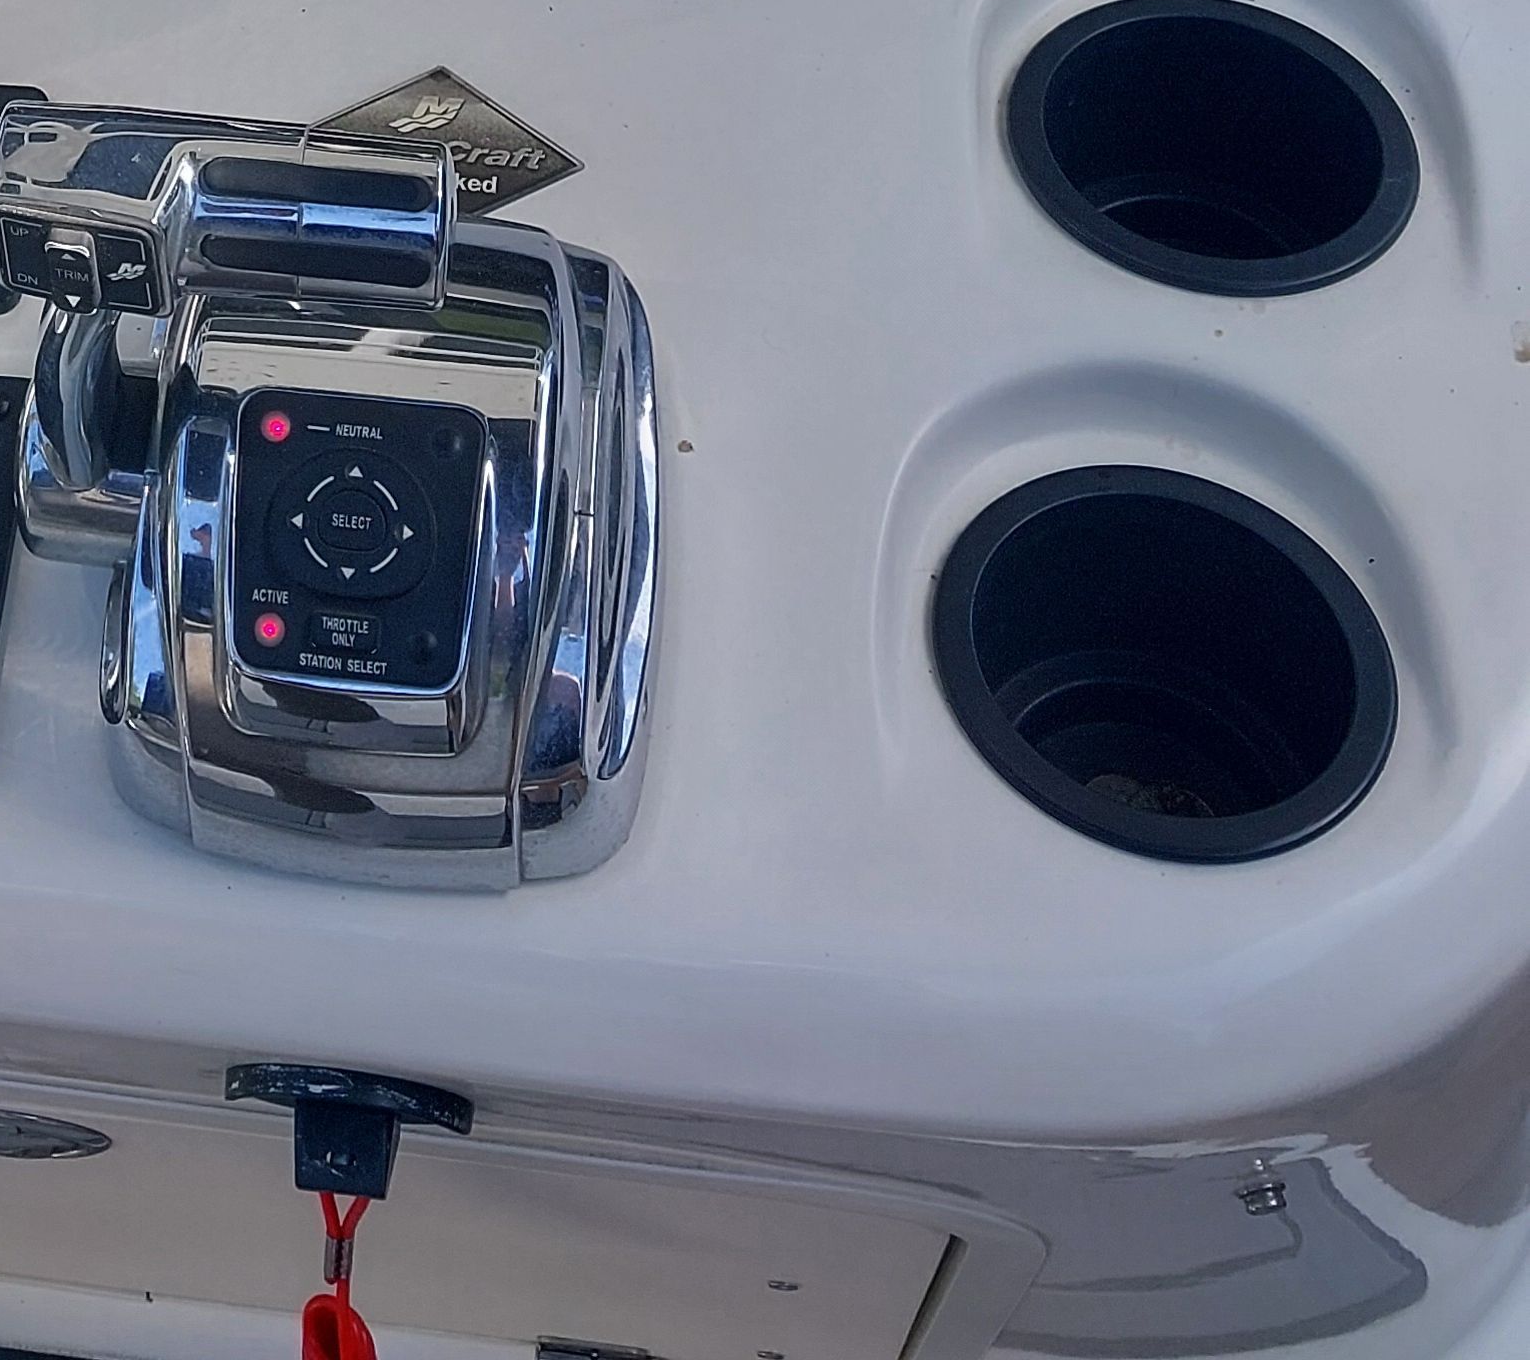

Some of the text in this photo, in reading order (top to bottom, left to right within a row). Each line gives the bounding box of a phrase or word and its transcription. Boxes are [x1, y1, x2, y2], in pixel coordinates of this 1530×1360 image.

[9, 225, 30, 238] UP
[17, 273, 39, 286] DN
[54, 268, 90, 283] TRIM
[335, 423, 383, 440] NEUTRAL
[331, 513, 372, 530] SELECT
[252, 588, 289, 605] ACTIVE
[321, 616, 369, 634] THROTTLE
[331, 632, 356, 647] ONLY
[299, 653, 388, 675] STATION SELECT
